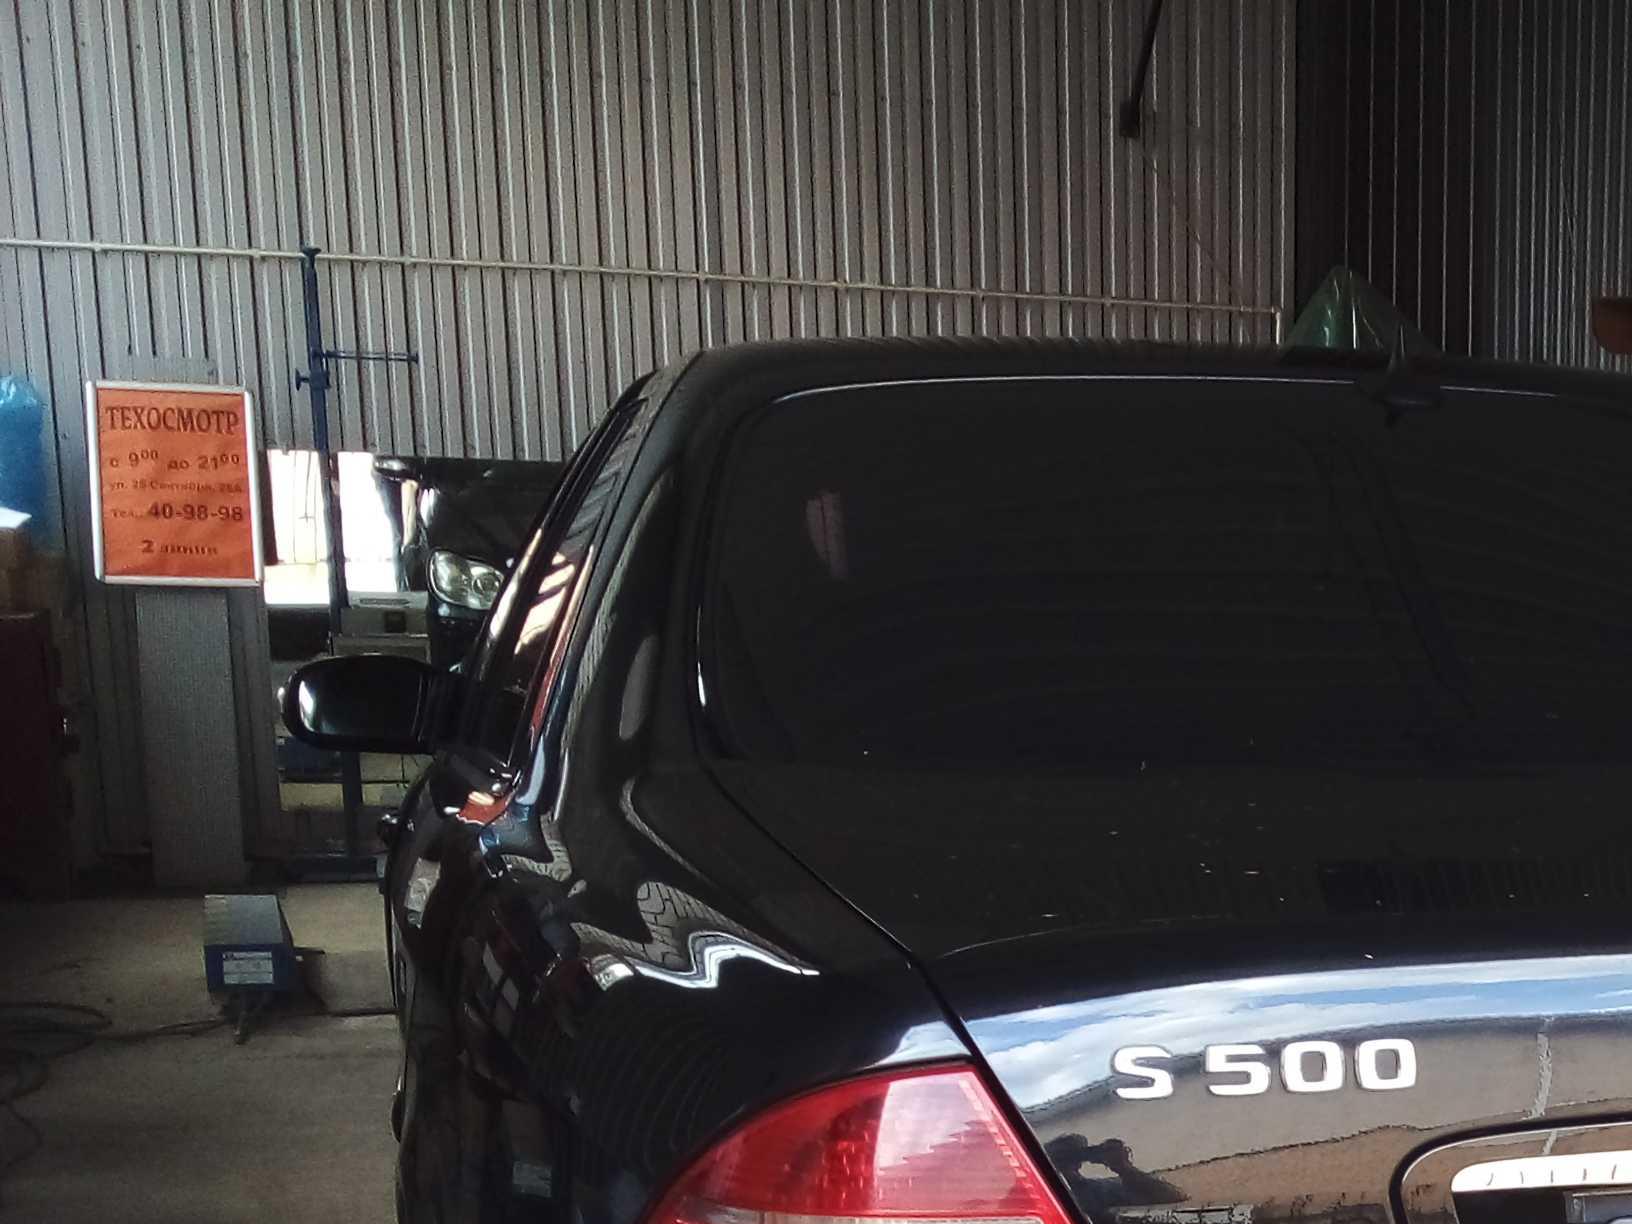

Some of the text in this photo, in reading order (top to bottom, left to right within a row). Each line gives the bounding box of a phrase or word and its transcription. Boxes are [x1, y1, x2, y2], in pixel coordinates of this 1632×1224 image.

[105, 406, 240, 435] ТЕХОСМОТР
[167, 458, 190, 471] до
[148, 501, 244, 522] 40-98-98
[141, 540, 154, 555] 2
[1112, 1037, 1418, 1100] S 500
